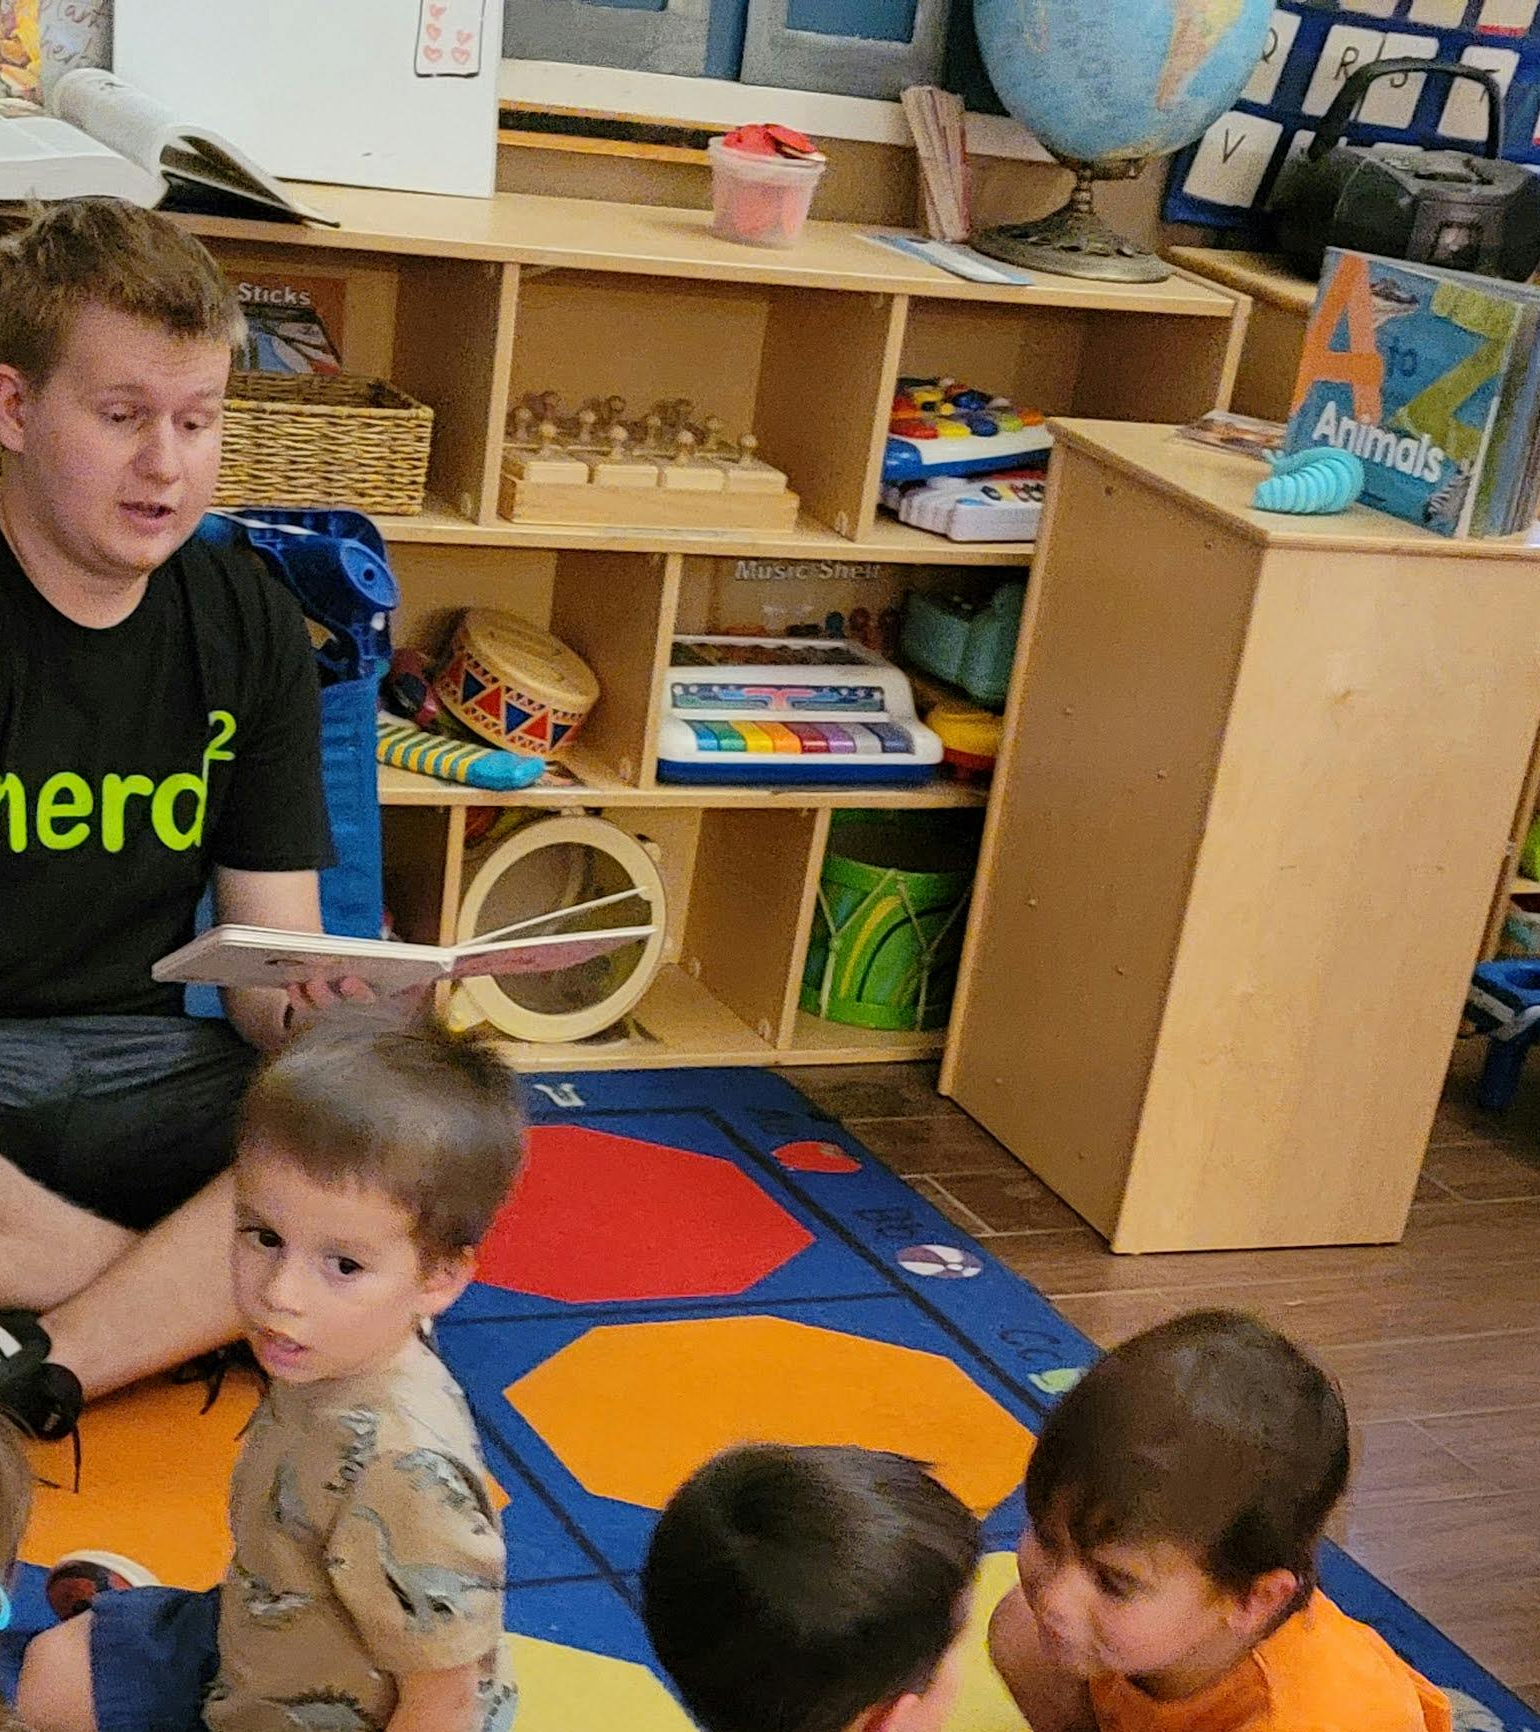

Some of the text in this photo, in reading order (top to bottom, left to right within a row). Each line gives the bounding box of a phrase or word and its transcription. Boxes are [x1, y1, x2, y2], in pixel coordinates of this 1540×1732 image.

[1334, 46, 1360, 80] R
[1222, 128, 1246, 163] V
[239, 282, 312, 306] Sticks
[1289, 251, 1522, 463] A to Z
[1312, 401, 1447, 483] Animals
[735, 559, 809, 581] Music
